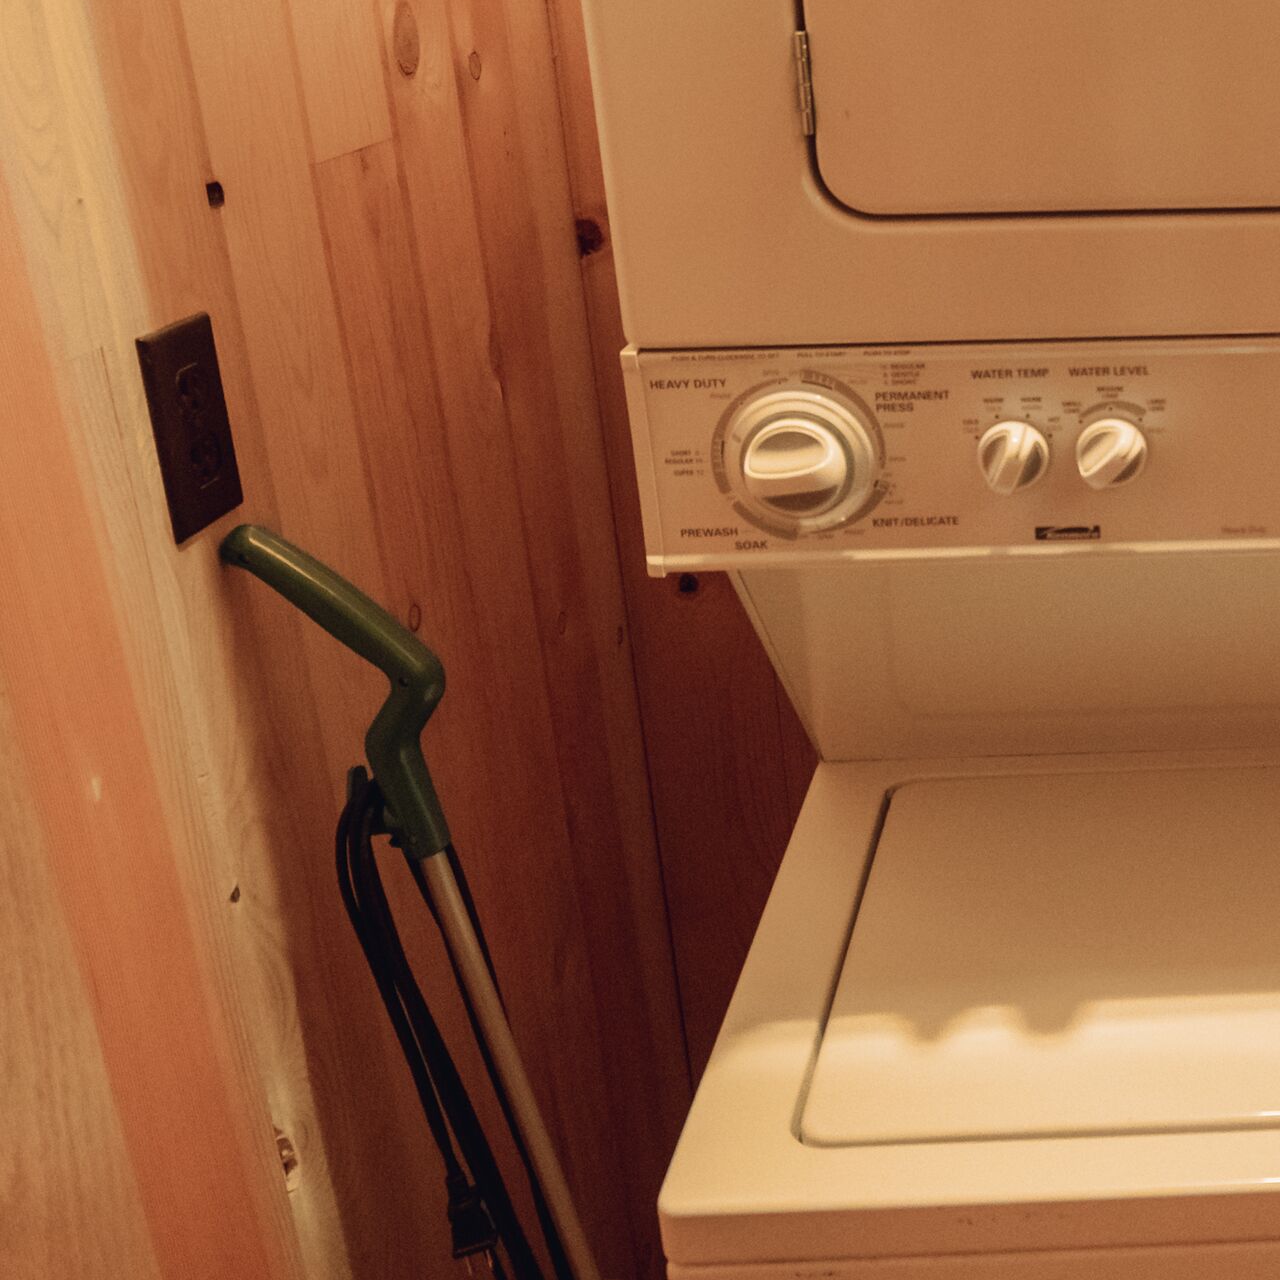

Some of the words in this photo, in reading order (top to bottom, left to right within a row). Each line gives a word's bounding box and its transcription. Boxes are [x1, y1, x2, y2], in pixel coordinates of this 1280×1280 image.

[970, 368, 1013, 380] WATER
[1017, 367, 1050, 378] TEMP
[1068, 366, 1110, 377] WATER
[1112, 365, 1150, 376] LEVEL
[649, 378, 690, 391] HEAVY
[693, 377, 727, 390] DUTY
[874, 389, 950, 402] PERMANENT
[875, 401, 915, 413] PRESS
[872, 515, 960, 528] KNIT/DELICATE
[680, 527, 739, 539] PREWASH
[734, 540, 769, 552] SOAK
